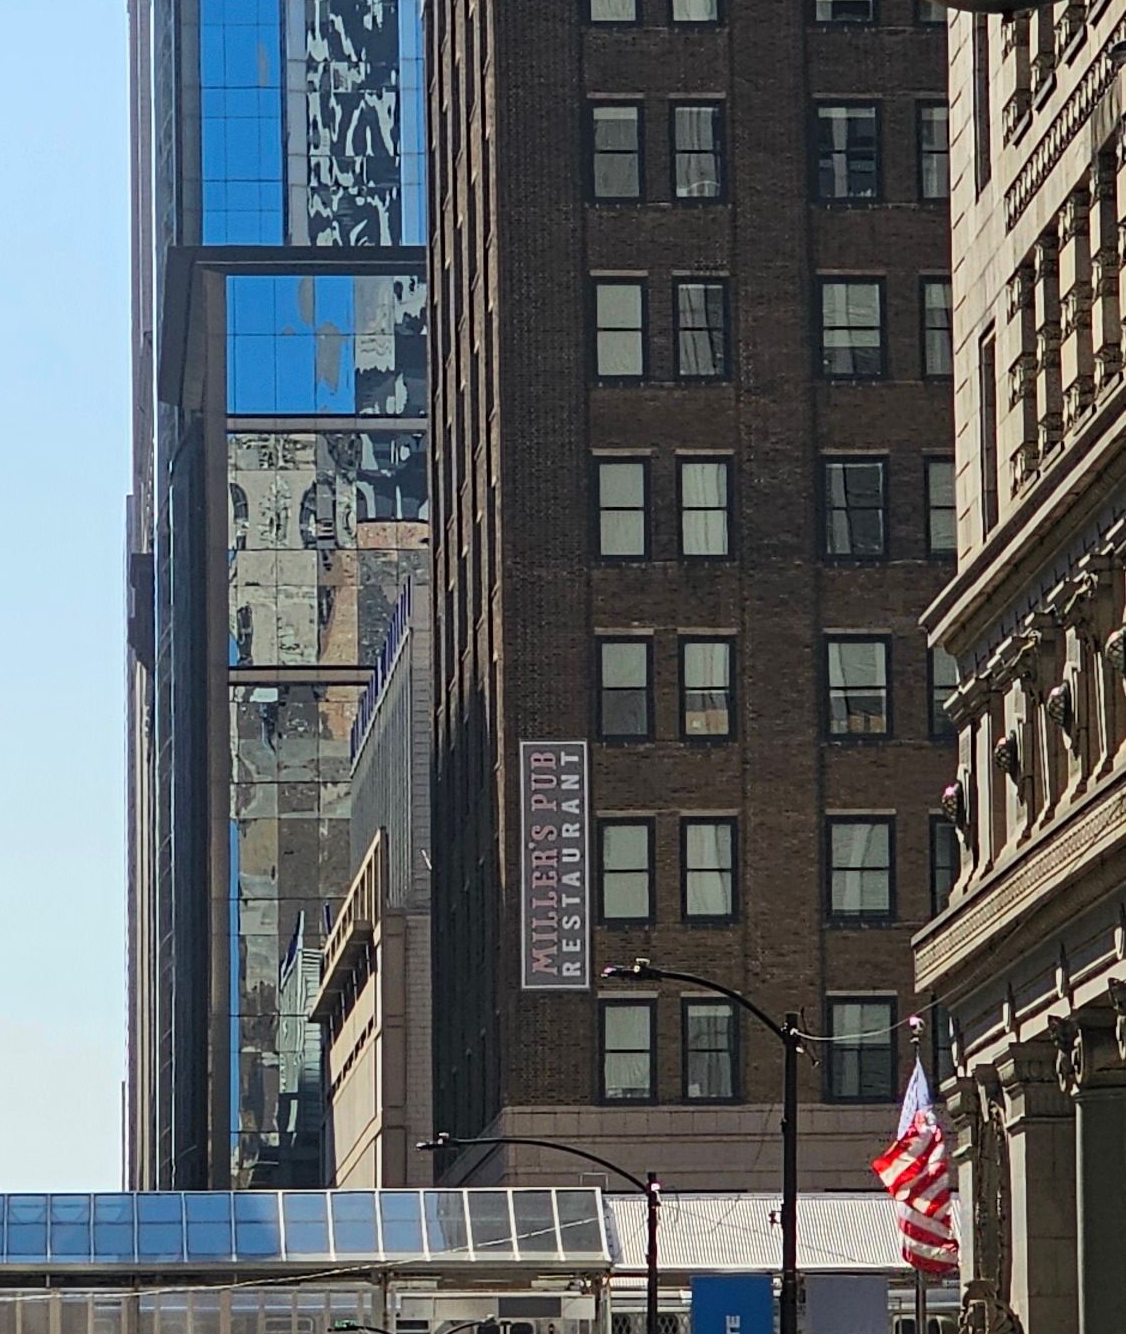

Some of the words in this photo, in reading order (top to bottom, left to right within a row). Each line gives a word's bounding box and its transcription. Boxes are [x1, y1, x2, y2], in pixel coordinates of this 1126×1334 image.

[530, 751, 558, 812] PUB
[528, 824, 558, 975] MILLER'S
[561, 751, 581, 977] RESTAURANT
